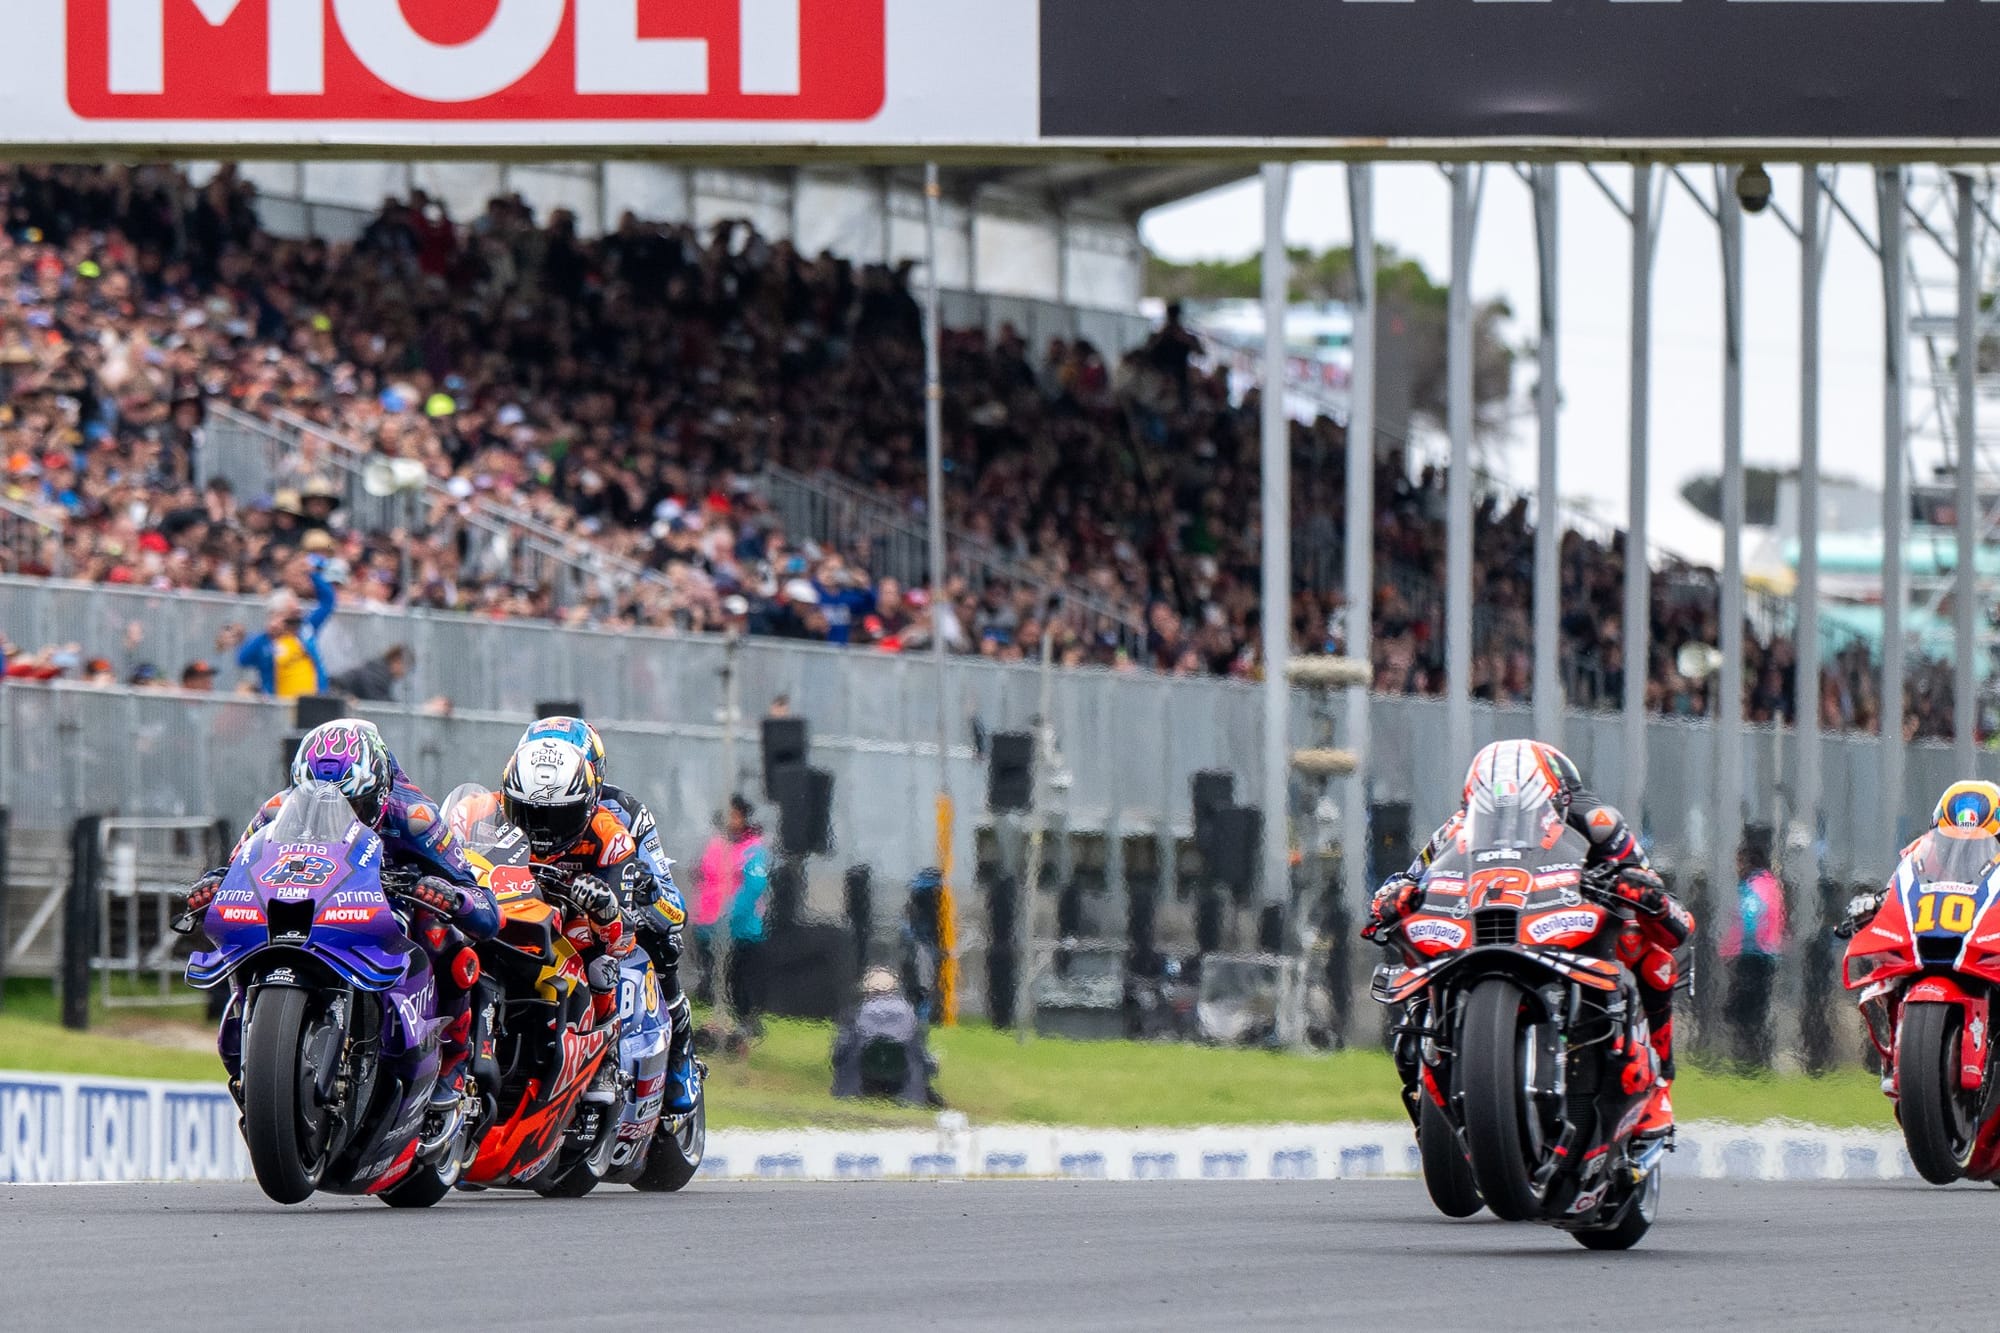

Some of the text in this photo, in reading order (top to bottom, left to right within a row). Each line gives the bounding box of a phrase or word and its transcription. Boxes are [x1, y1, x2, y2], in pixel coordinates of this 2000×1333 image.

[278, 843, 328, 857] prima
[1476, 848, 1522, 862] aprilia
[260, 854, 337, 886] 43
[277, 888, 310, 898] FIAMM
[1469, 867, 1533, 914] 72
[1933, 884, 1976, 893] Castrol
[215, 890, 255, 905] prima
[333, 891, 384, 907] prima
[223, 909, 259, 920] MOTUL
[325, 909, 370, 920] MOTUL
[1914, 894, 1976, 933] 10
[1410, 921, 1461, 943] sterilgarda
[1533, 913, 1594, 937] sterilgarda
